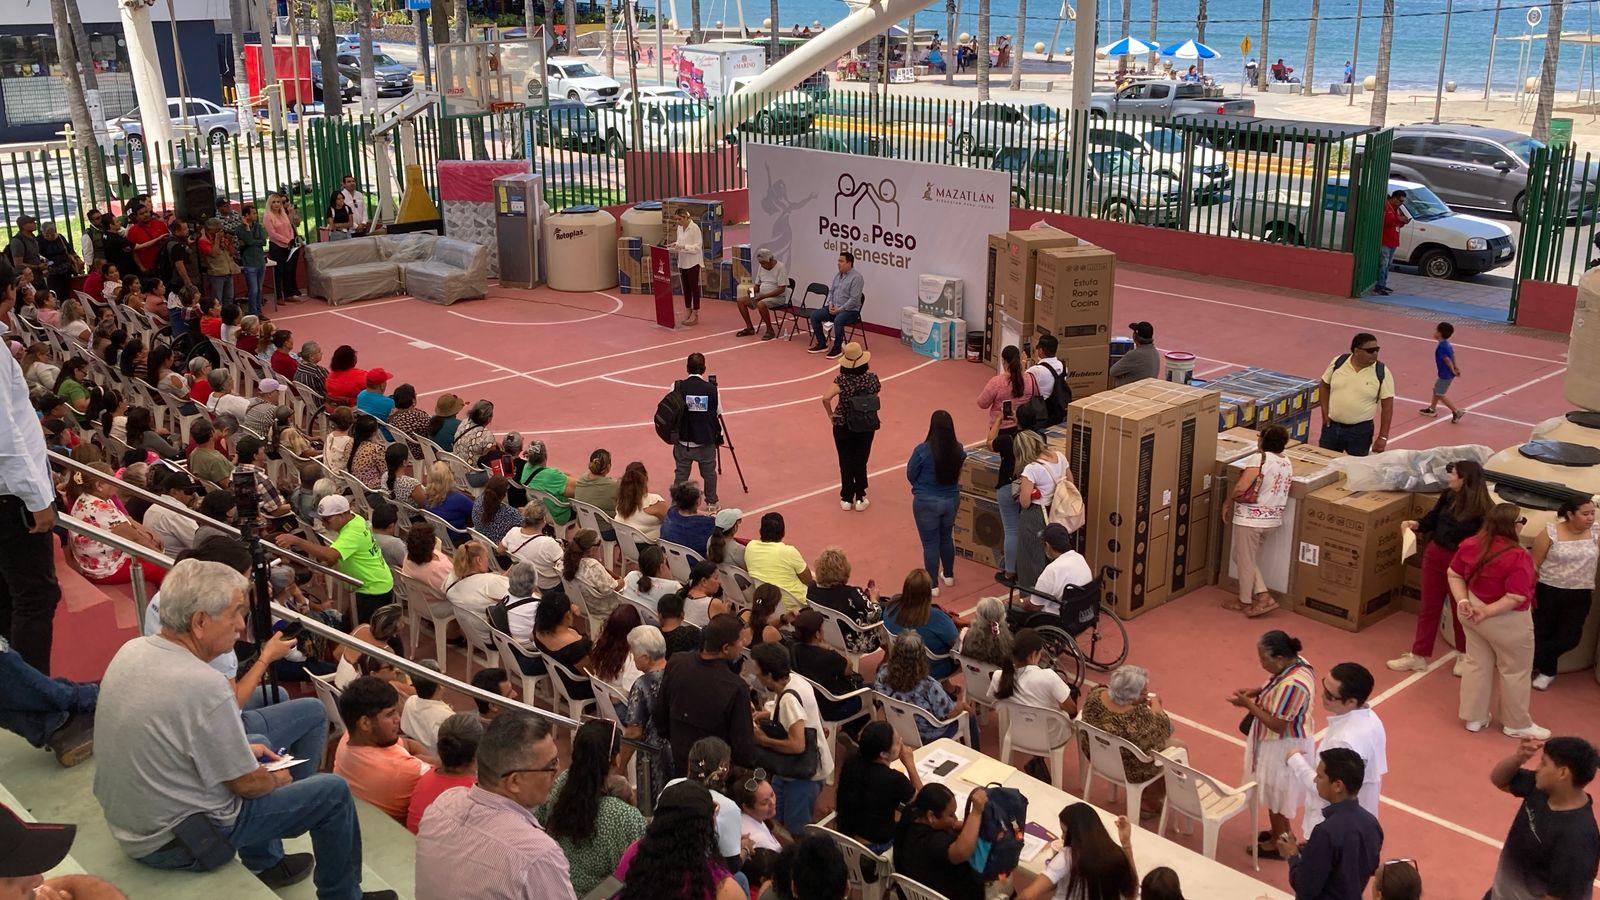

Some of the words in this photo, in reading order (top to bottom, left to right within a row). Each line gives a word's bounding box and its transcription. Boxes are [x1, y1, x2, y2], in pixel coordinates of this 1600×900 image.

[936, 188, 994, 204] MAZATLÁN
[556, 229, 584, 240] Rotoplas
[819, 215, 861, 241] Peso
[862, 232, 869, 243] a
[872, 224, 917, 250] Peso
[823, 239, 838, 251] del
[839, 242, 912, 270] Bienestar
[1073, 278, 1099, 287] Estufa
[1072, 289, 1099, 298] Range
[1070, 299, 1100, 308] Cocina
